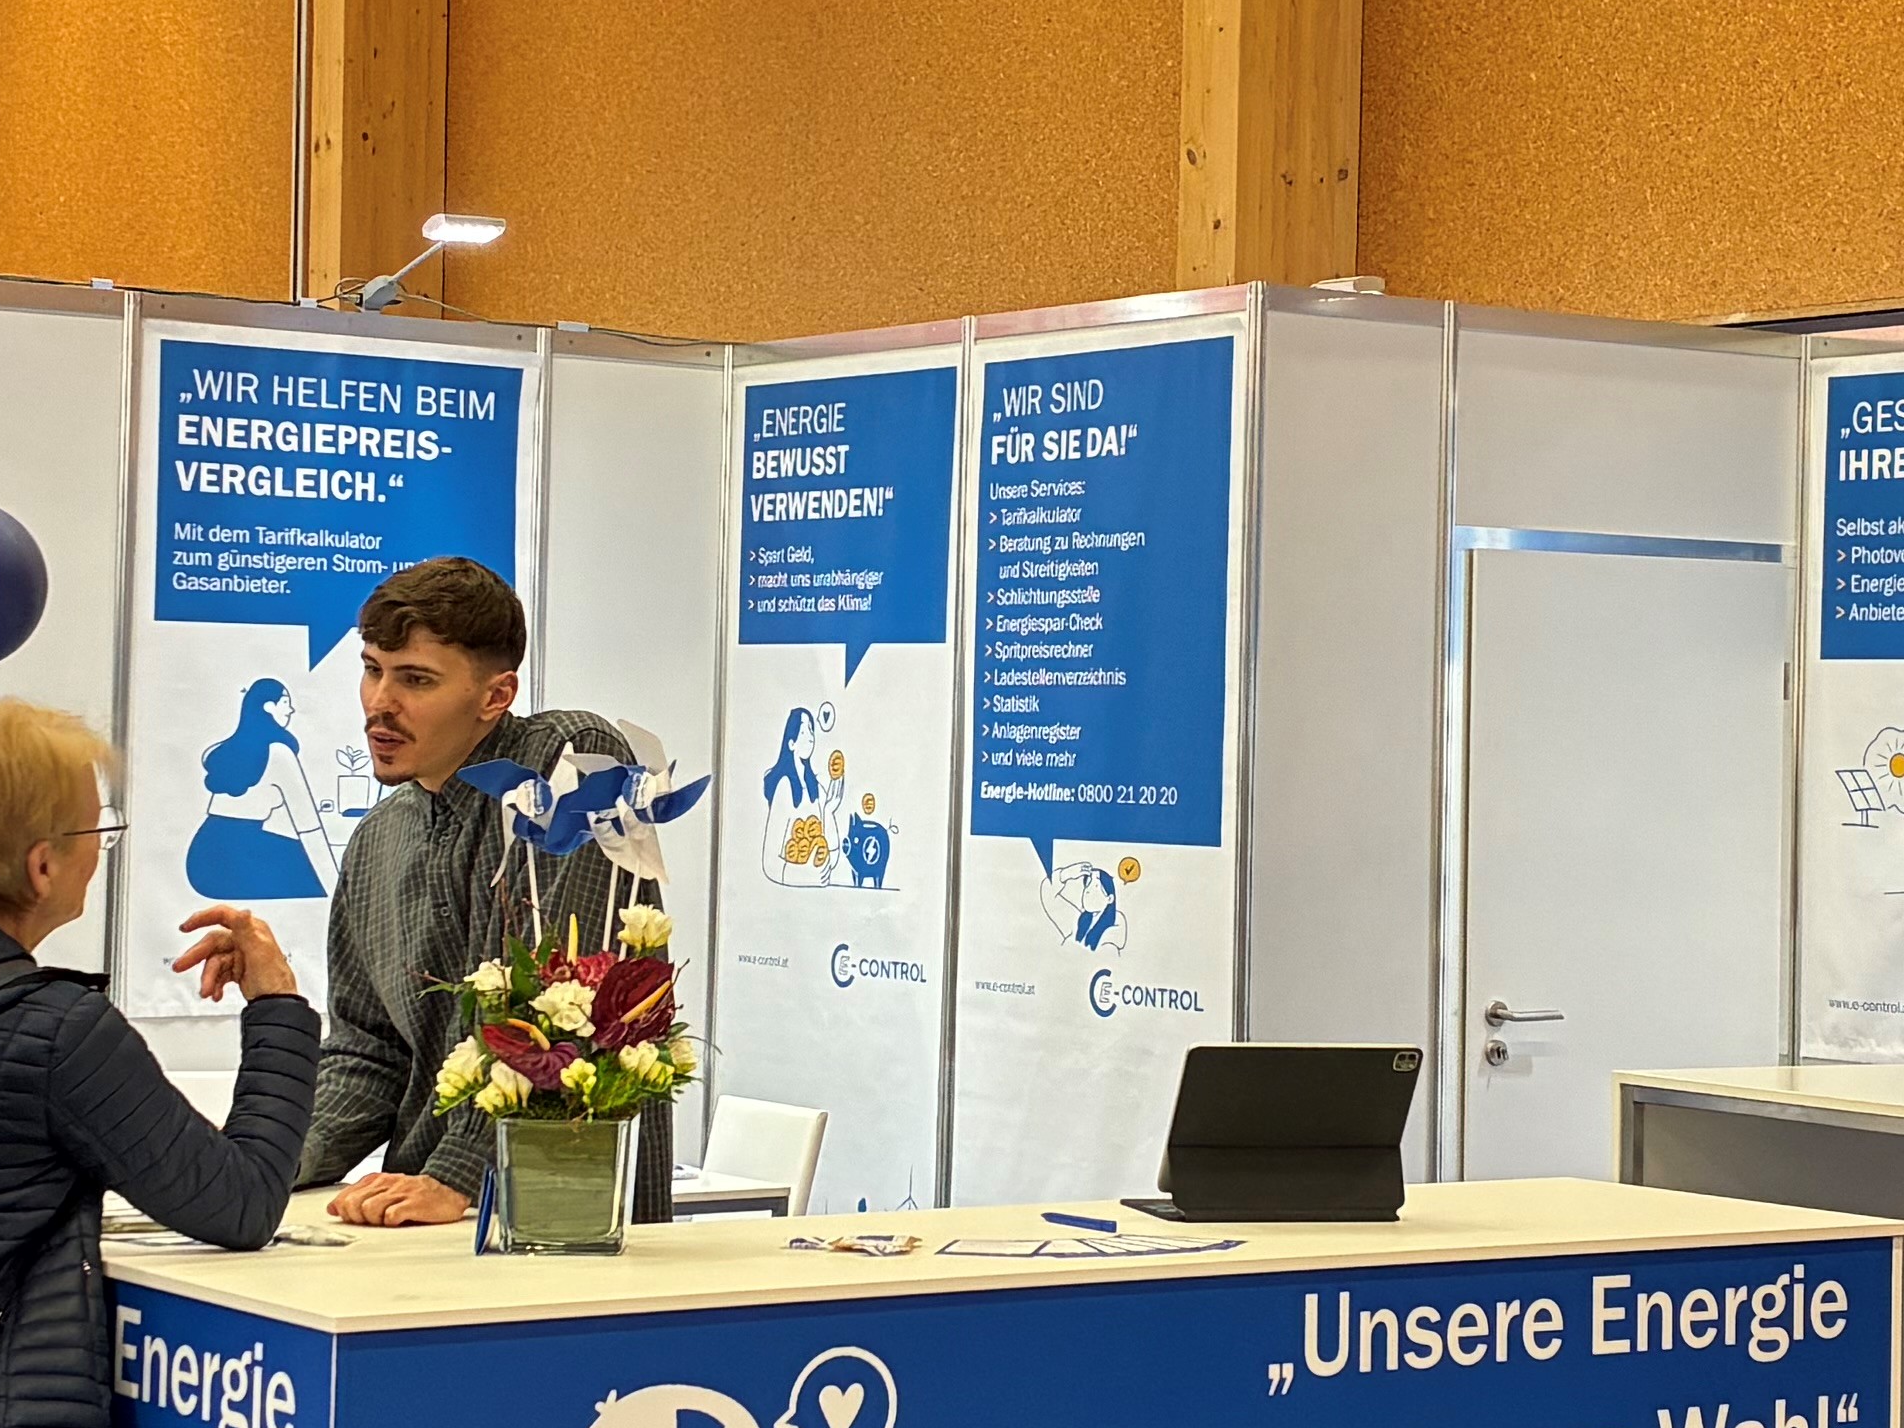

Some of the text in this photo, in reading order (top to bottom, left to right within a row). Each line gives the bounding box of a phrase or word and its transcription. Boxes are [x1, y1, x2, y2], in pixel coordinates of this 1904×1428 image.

[273, 375, 401, 414] HELFEN
[416, 386, 495, 421] BEIM
[1050, 379, 1103, 414] SIND
[178, 414, 452, 461] ENERGIEPREIS-
[991, 426, 1035, 465] FÜR
[1042, 429, 1081, 461] SIE
[752, 445, 849, 479] BEWUSST
[990, 479, 1086, 500] Unsere Services:
[1001, 506, 1082, 526] Tarifkalkulator
[1836, 518, 1885, 536] Selbst
[174, 522, 382, 549] Mit dem Tarifkalkulator
[1000, 531, 1145, 555] Beratung zu Rechnungen
[173, 551, 212, 566] zum
[217, 549, 327, 574] günstigeren
[332, 554, 388, 574] Strom-
[758, 546, 814, 566] Spart Geld,
[790, 574, 811, 587] uns
[999, 559, 1098, 581] und Streitigkeiten
[173, 572, 291, 594] Gasanbieter.
[757, 597, 776, 613] und
[817, 595, 836, 612] das
[996, 585, 1100, 608] Schlichtungsstelle
[996, 613, 1103, 636] Energiespar-Check
[994, 641, 1093, 662] Spritpreisrechner
[993, 694, 1039, 712] Statistik
[992, 722, 1081, 744] Anlagenregister
[992, 749, 1076, 767] und viele mehr
[980, 781, 1177, 805] Energie-Hotline: 0800 21 20 20
[1592, 1264, 1848, 1362] Energie
